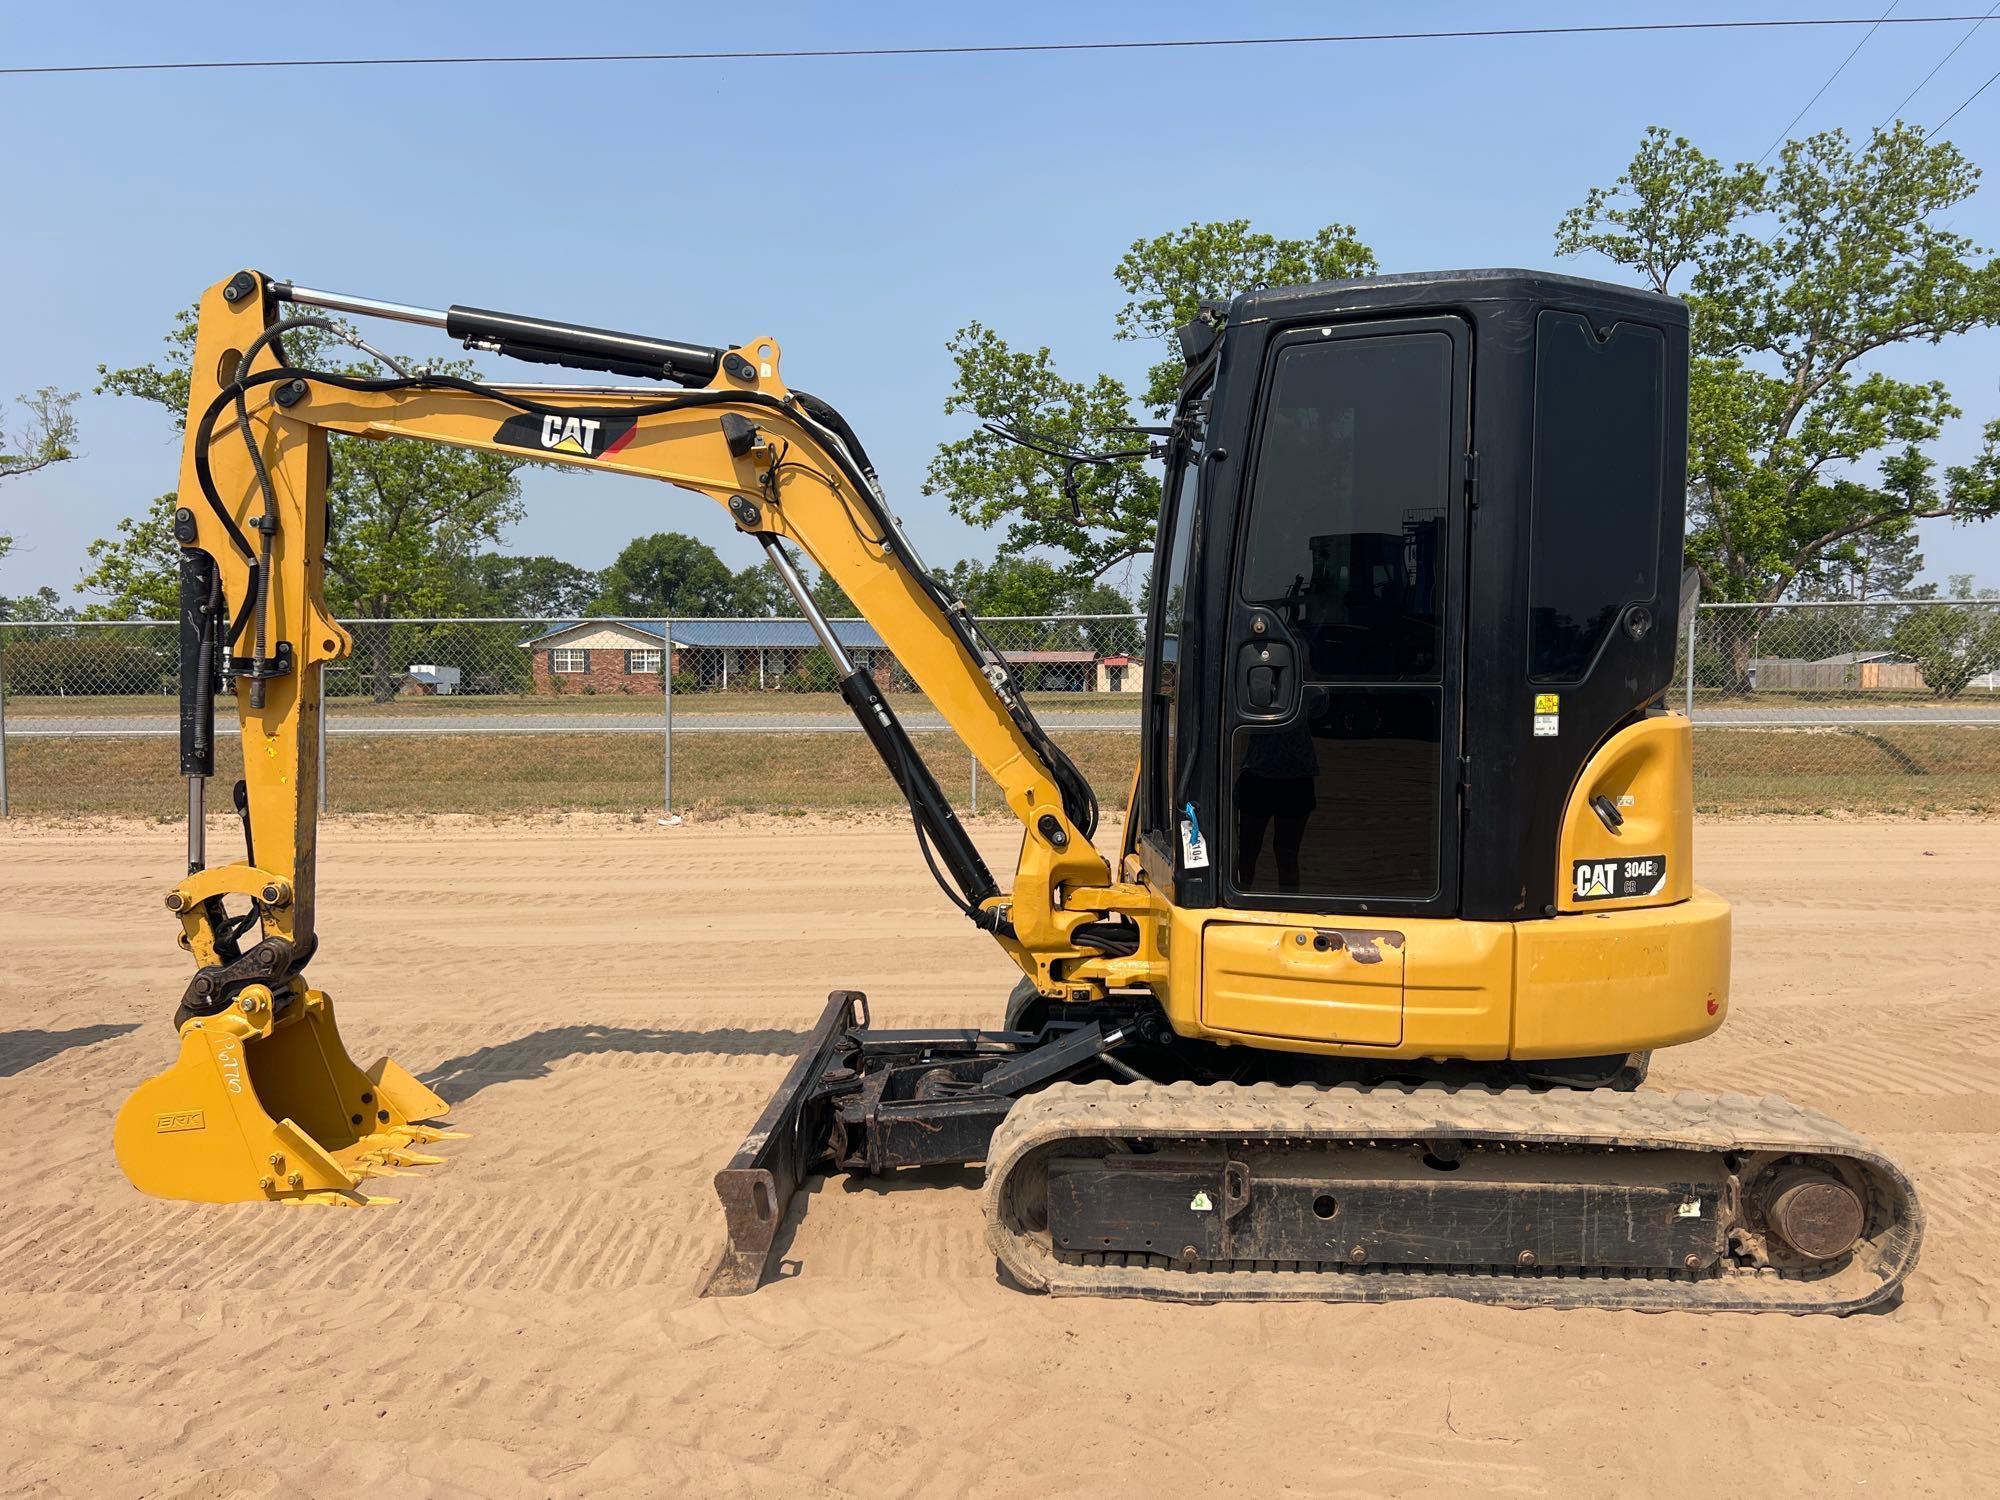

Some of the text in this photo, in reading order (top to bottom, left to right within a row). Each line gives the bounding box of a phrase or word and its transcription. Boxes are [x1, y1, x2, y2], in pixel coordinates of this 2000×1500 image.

[541, 414, 601, 455] CAT
[1577, 860, 1659, 896] CAT 304E2
[1624, 880, 1637, 893] CR
